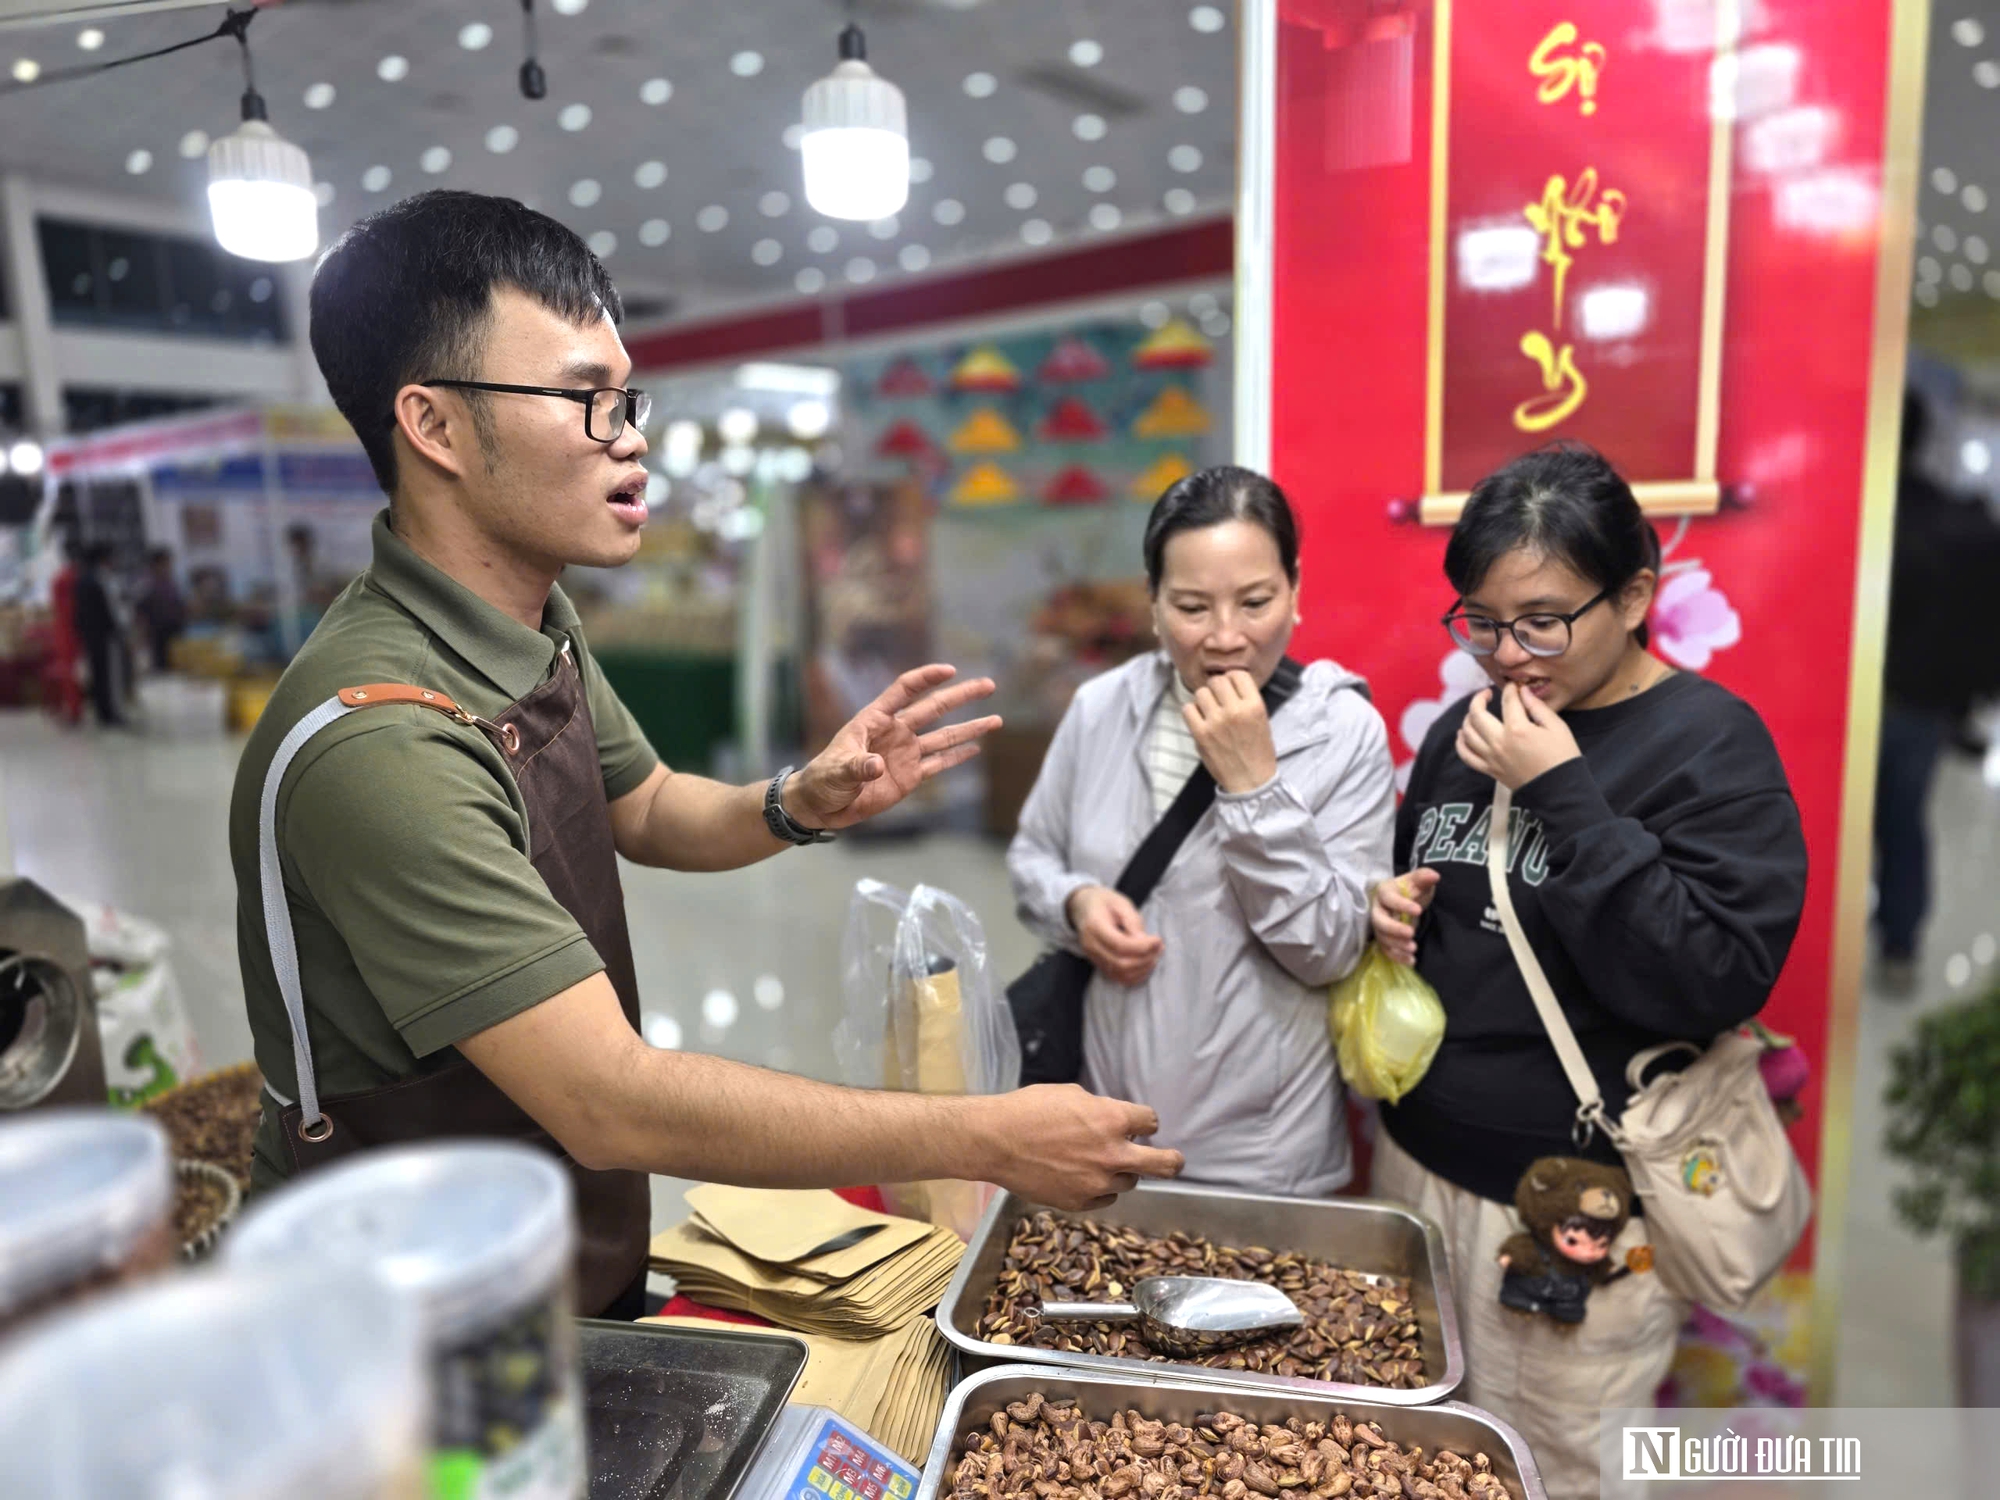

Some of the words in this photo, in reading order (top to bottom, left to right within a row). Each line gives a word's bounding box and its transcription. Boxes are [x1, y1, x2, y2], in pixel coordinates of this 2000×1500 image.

[822, 1452, 838, 1470] M1
[831, 1435, 846, 1452] M2
[843, 1468, 857, 1485] M3
[852, 1449, 867, 1467] M4
[864, 1481, 878, 1499] M5
[873, 1463, 887, 1481] M6
